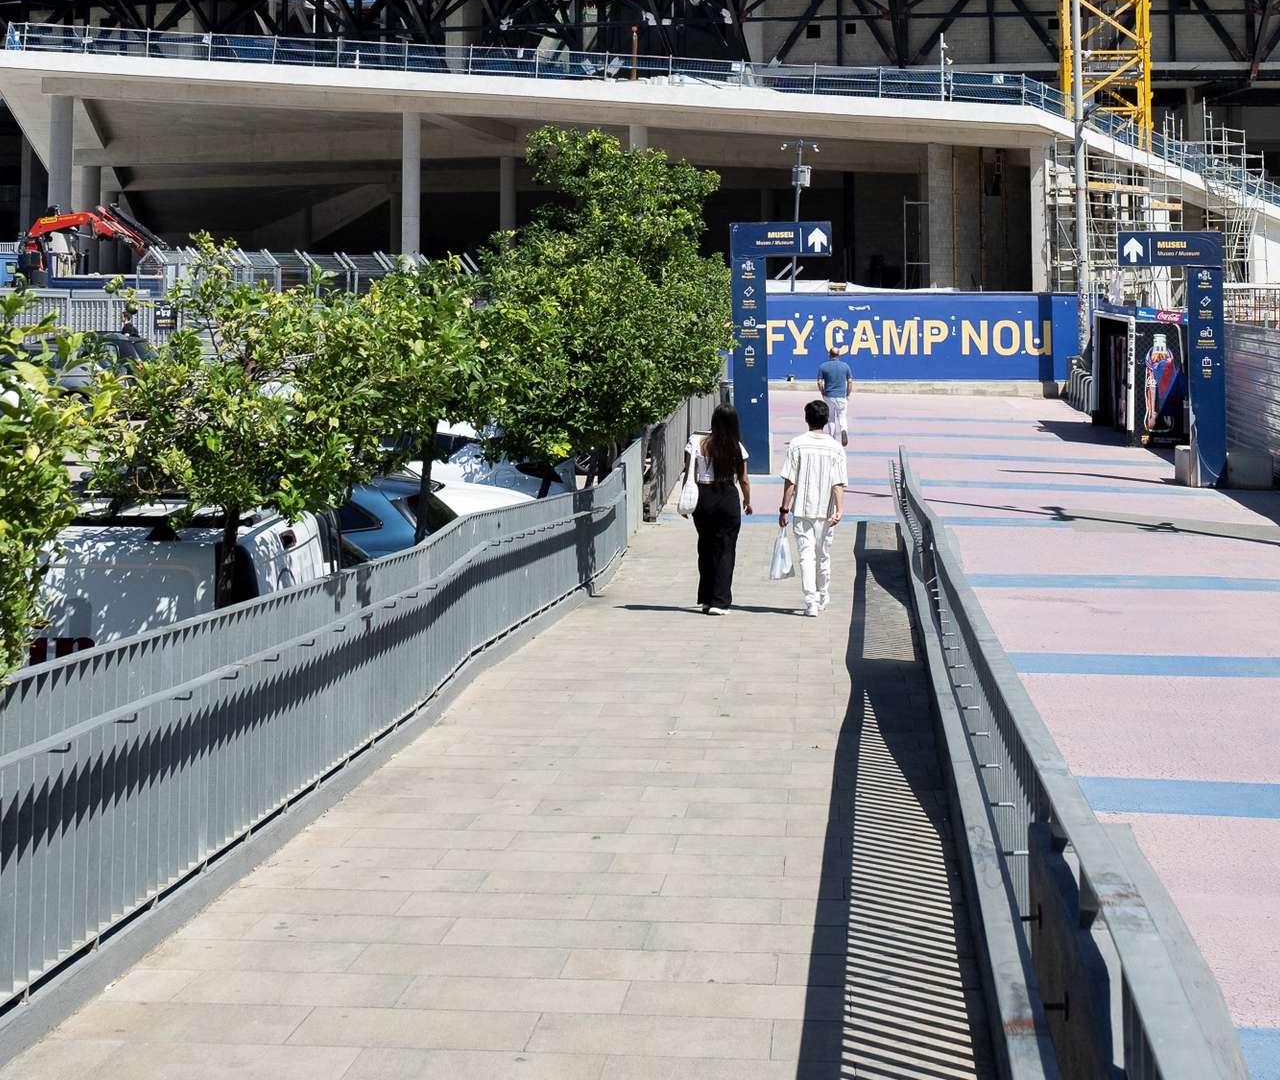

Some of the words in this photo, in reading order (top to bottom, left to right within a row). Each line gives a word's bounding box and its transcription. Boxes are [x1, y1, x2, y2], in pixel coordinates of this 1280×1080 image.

[767, 231, 794, 239] MUSEU
[1157, 241, 1187, 249] MUSEU
[824, 319, 949, 356] CAMP
[961, 319, 1052, 356] NOU
